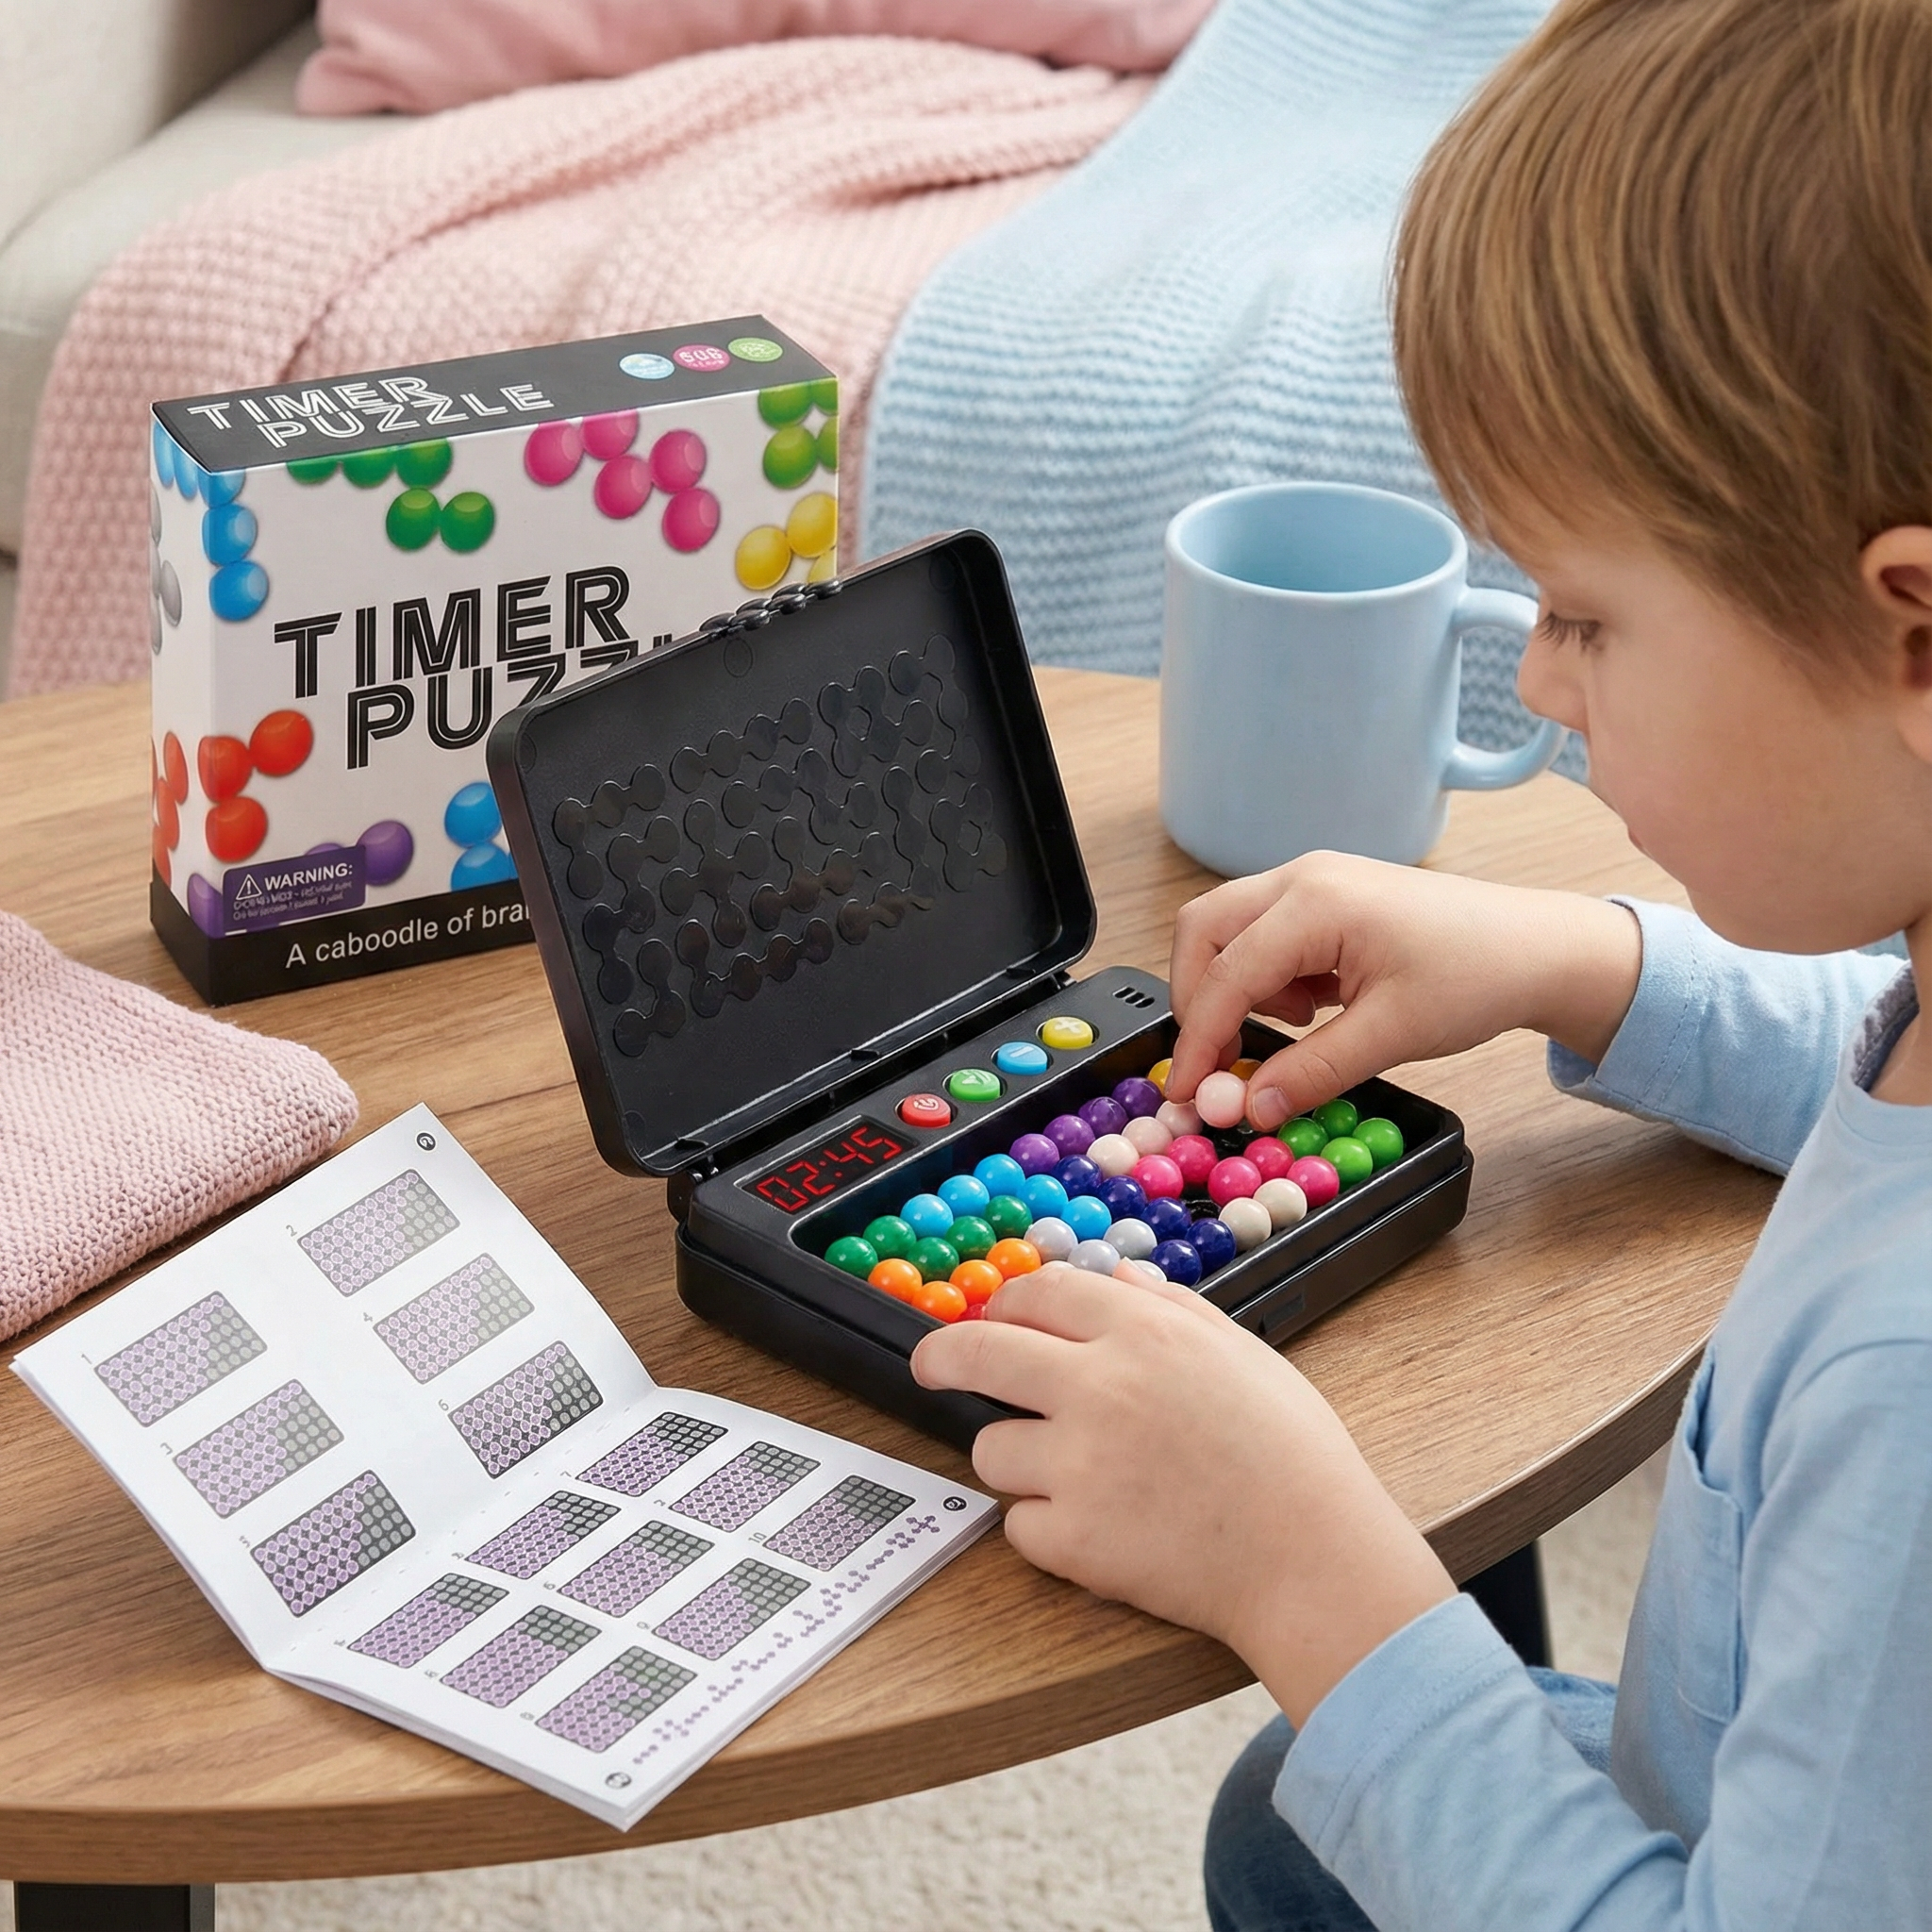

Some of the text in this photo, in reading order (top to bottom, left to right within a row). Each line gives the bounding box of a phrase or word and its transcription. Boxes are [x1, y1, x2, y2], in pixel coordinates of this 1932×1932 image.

[188, 377, 450, 430] TIMER
[258, 384, 555, 449] PUZZLE
[274, 565, 631, 699] TIMER
[346, 633, 673, 771] PUZ
[264, 863, 353, 891] WARNING:
[285, 943, 307, 969] A
[314, 918, 439, 962] caboodle
[447, 908, 475, 935] of
[755, 1125, 903, 1212] 02:45
[286, 1224, 297, 1238] 2
[439, 1398, 450, 1412] 6
[748, 1531, 768, 1544] 10
